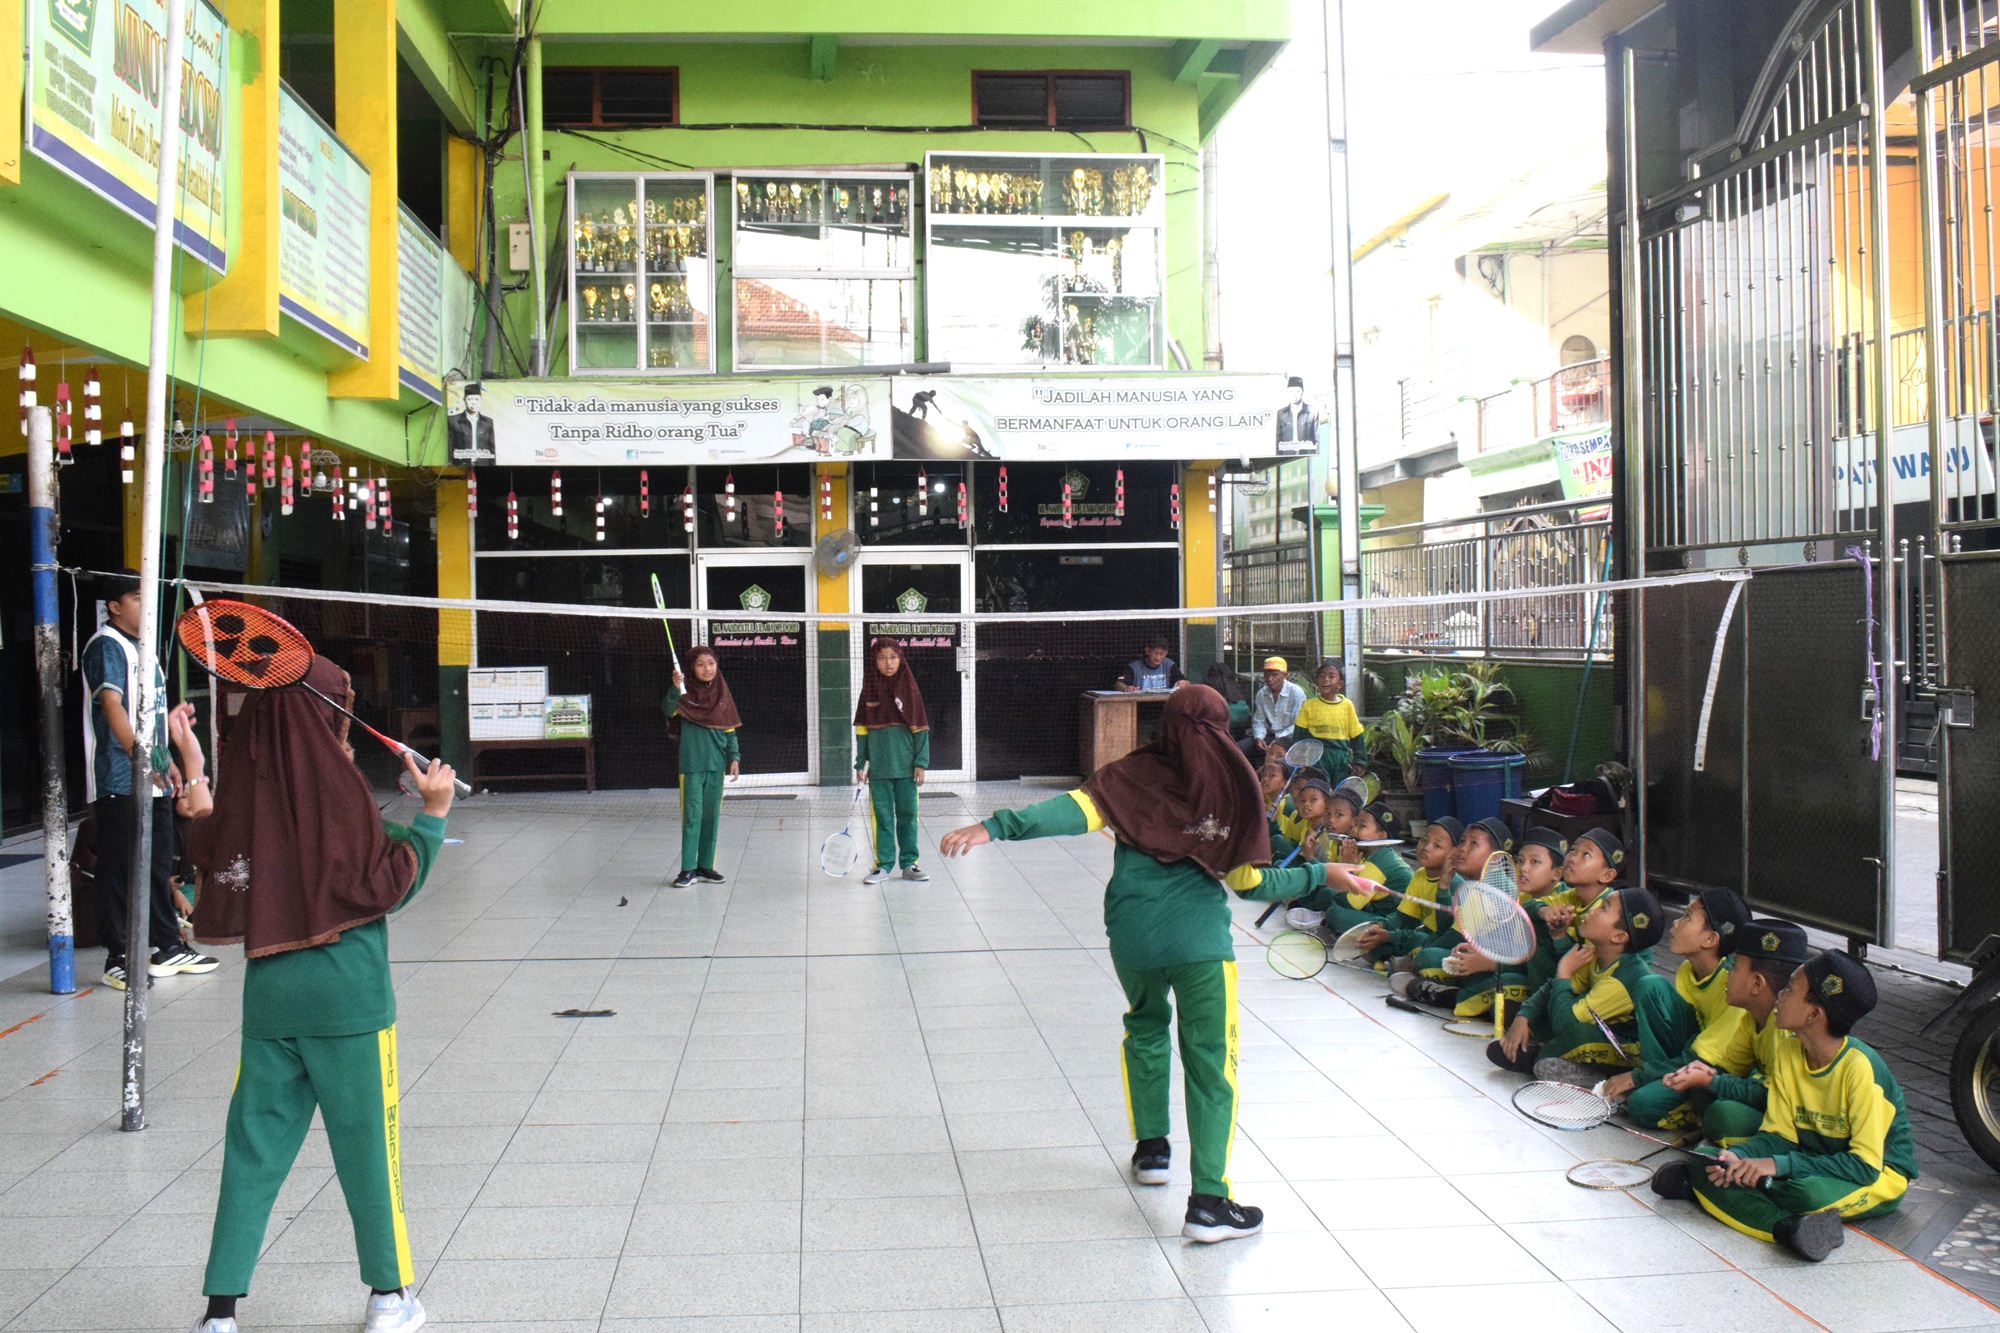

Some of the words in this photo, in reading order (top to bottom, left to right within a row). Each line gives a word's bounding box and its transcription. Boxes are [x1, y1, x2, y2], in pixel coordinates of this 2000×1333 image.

[1116, 390, 1188, 403] MANUSIA
[1192, 389, 1234, 401] YANG
[527, 399, 574, 413] Tidak
[578, 399, 606, 413] ada
[610, 399, 679, 413] manusia
[683, 401, 722, 415] yang
[726, 398, 778, 411] sukses
[997, 418, 1104, 430] BERMANFAAT
[1108, 417, 1162, 429] UNTUK
[1166, 416, 1224, 428] ORANG
[551, 425, 601, 442] Tanpa
[605, 425, 653, 438] Ridho
[657, 427, 704, 442] orang
